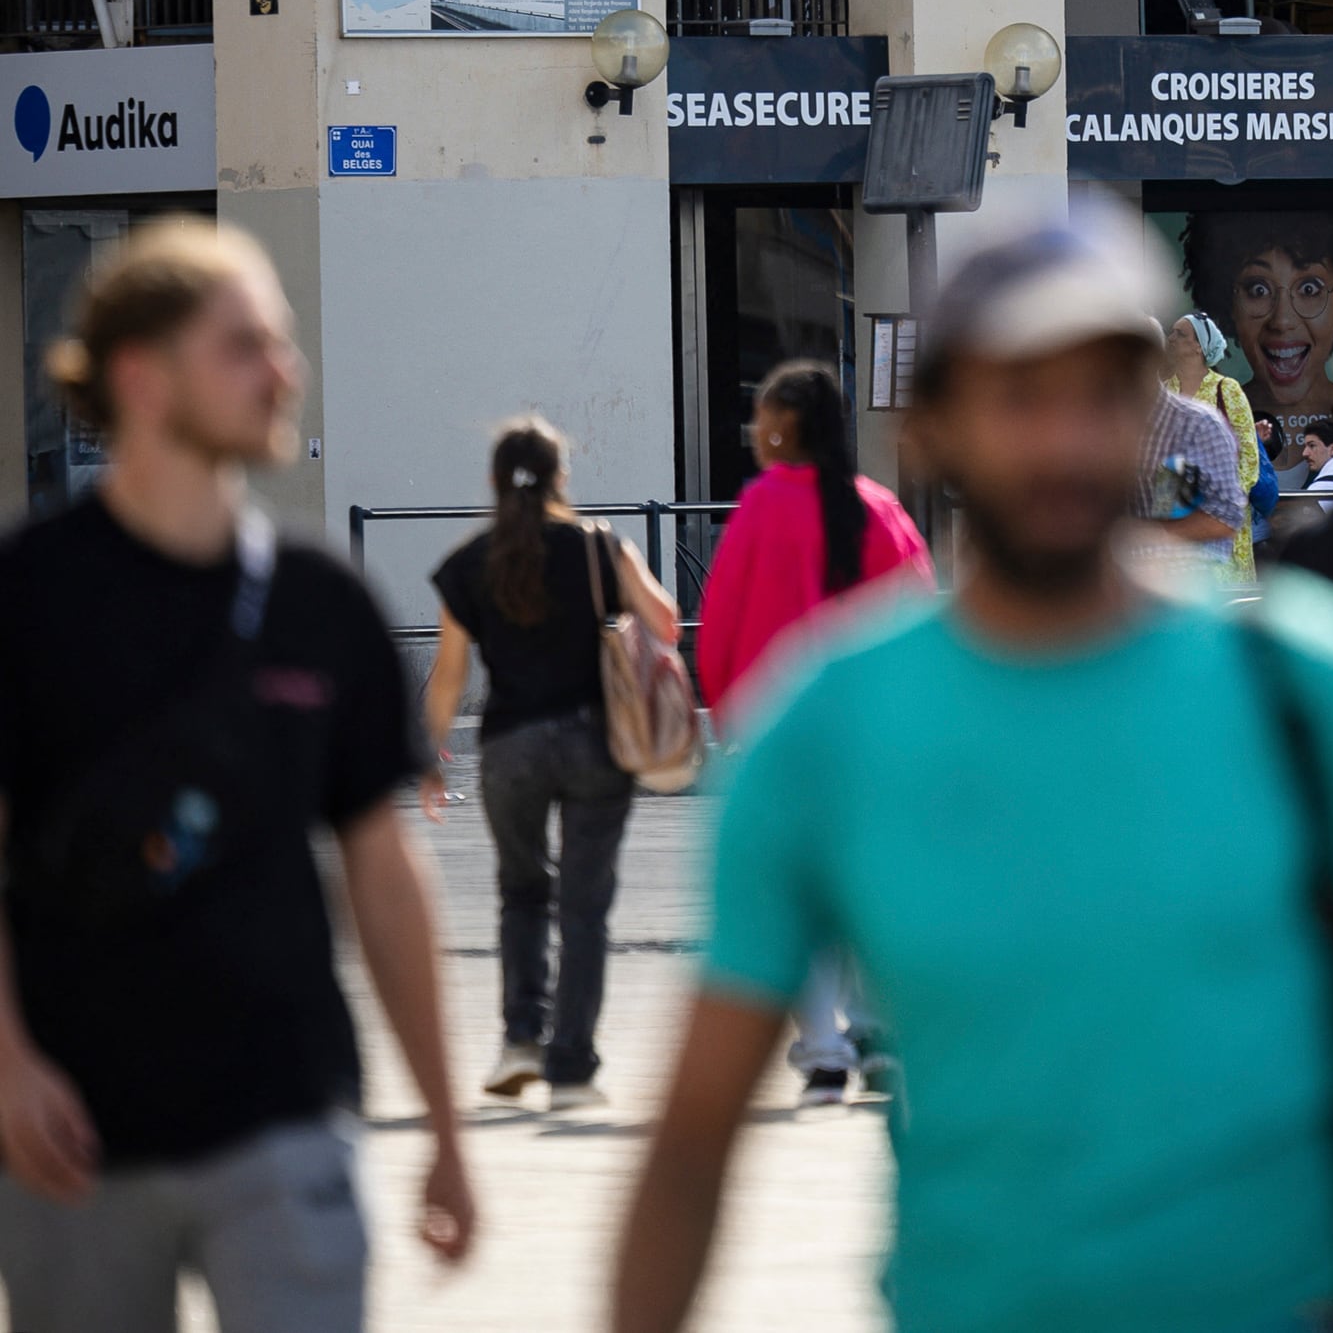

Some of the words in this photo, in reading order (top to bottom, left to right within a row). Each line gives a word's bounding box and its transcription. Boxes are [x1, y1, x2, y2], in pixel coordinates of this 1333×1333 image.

[1151, 72, 1315, 100] CROISIERES
[667, 91, 872, 127] SEASECURE
[57, 97, 178, 152] Audika
[1065, 114, 1239, 145] CALANQUES
[351, 140, 374, 149] QUAI
[354, 150, 371, 158] des
[343, 160, 383, 169] BELGES
